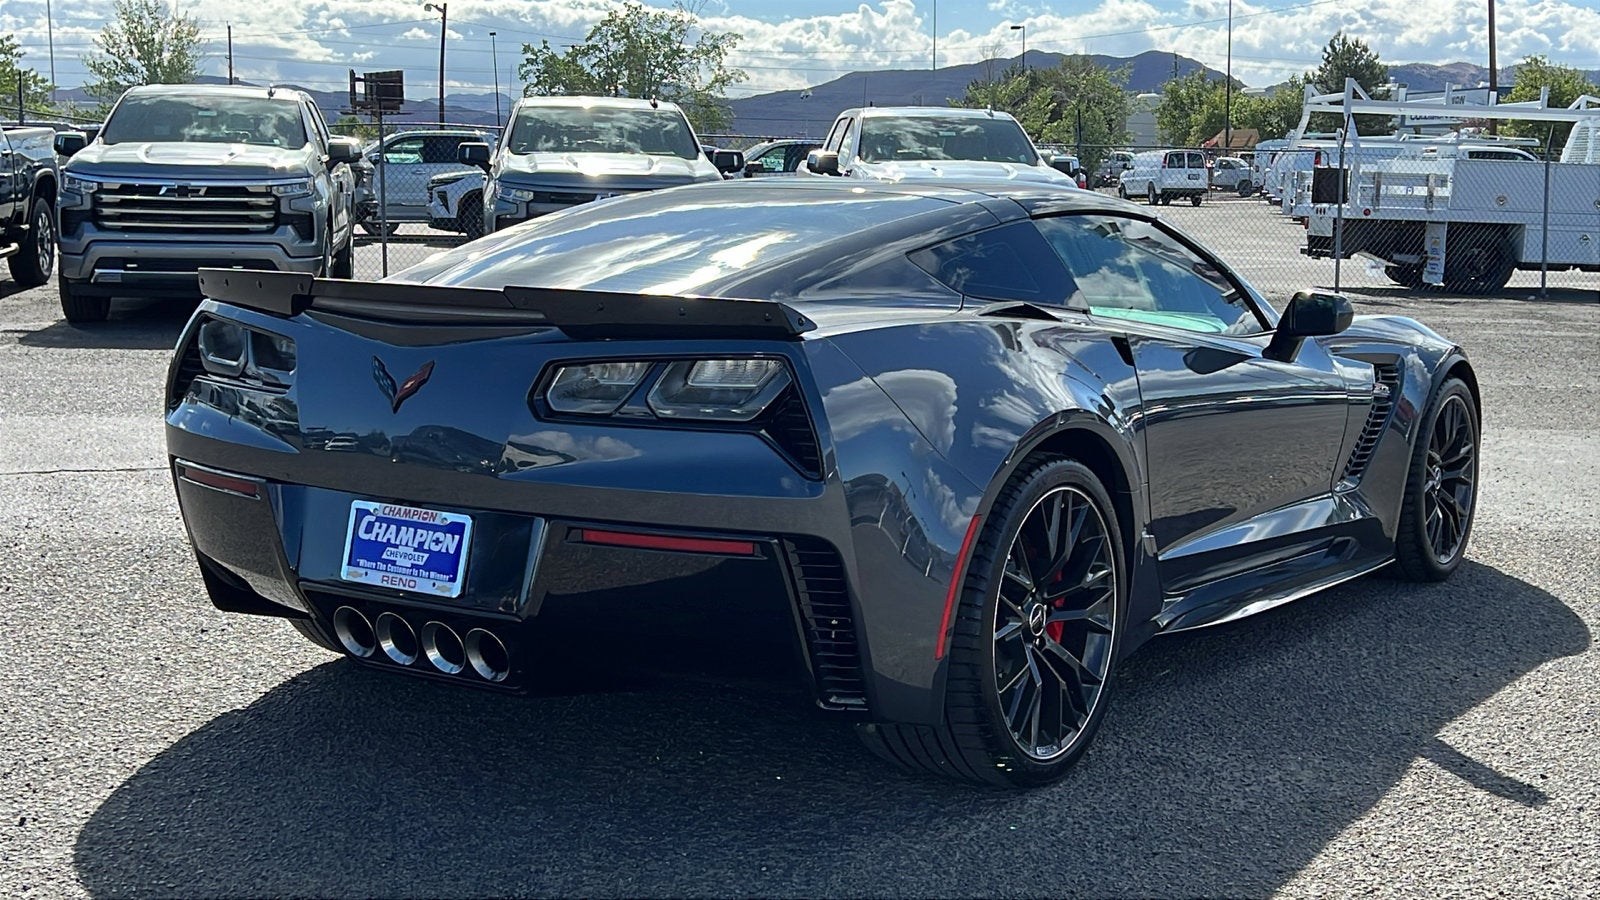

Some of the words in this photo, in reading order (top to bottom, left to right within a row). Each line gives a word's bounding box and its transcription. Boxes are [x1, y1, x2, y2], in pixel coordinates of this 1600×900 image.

[382, 505, 438, 522] CHAMPION
[358, 514, 460, 555] CHAMPION
[385, 549, 425, 563] CHEVROLET
[376, 562, 387, 571] The
[387, 564, 412, 576] Customer
[412, 568, 419, 577] Is
[419, 569, 429, 579] The
[381, 575, 417, 589] RENO
